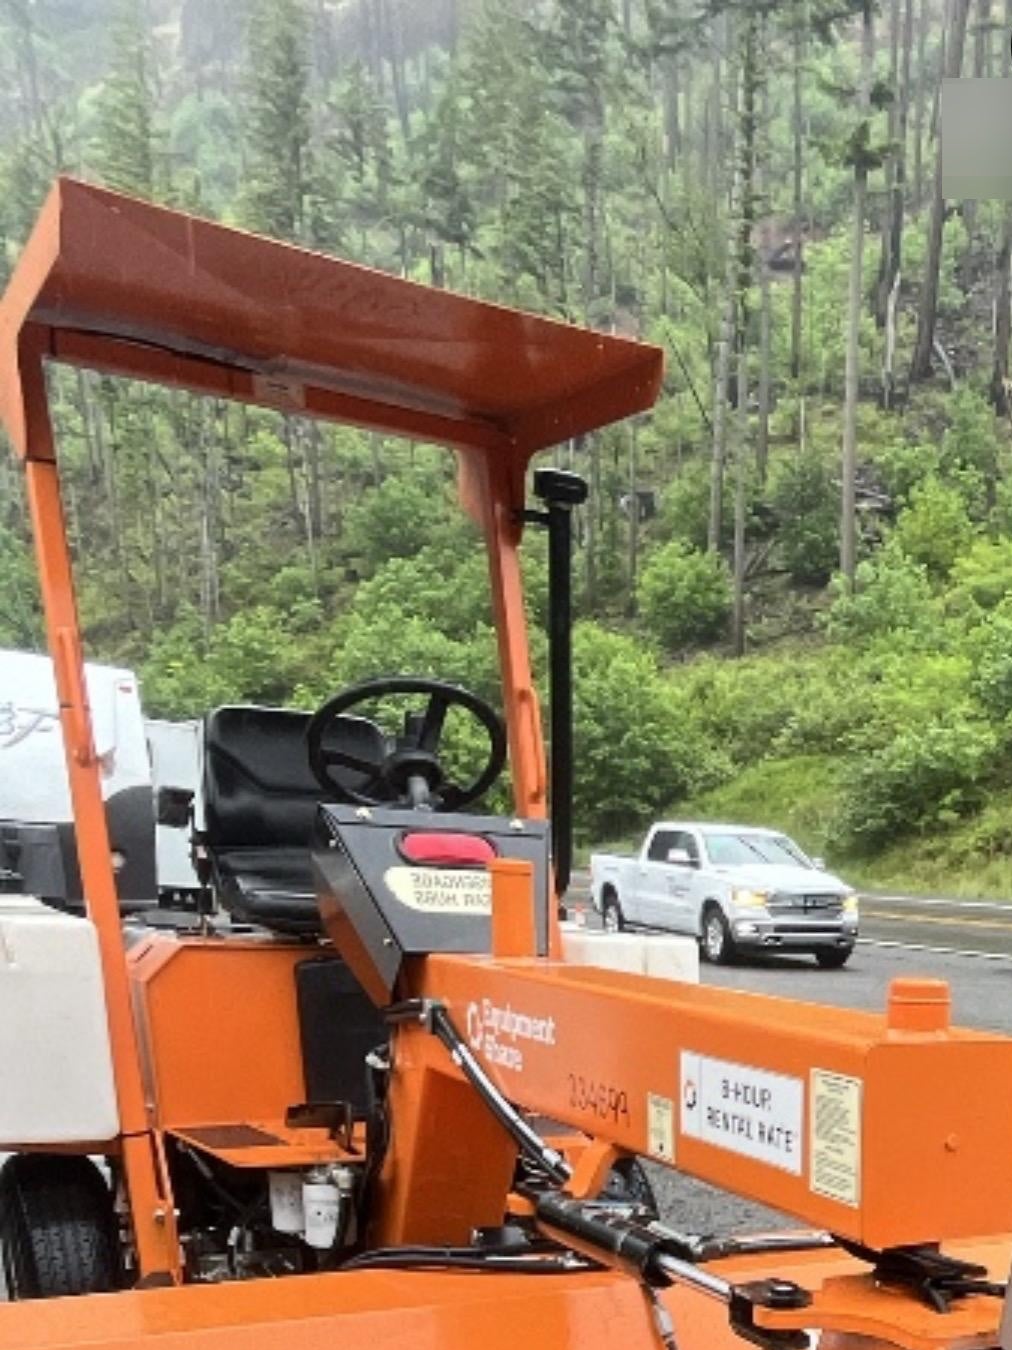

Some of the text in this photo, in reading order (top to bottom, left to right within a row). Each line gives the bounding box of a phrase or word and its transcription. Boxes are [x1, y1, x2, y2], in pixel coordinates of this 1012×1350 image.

[482, 998, 556, 1045] Equipment
[707, 1106, 754, 1142] RENTAL
[758, 1121, 793, 1154] RATE
